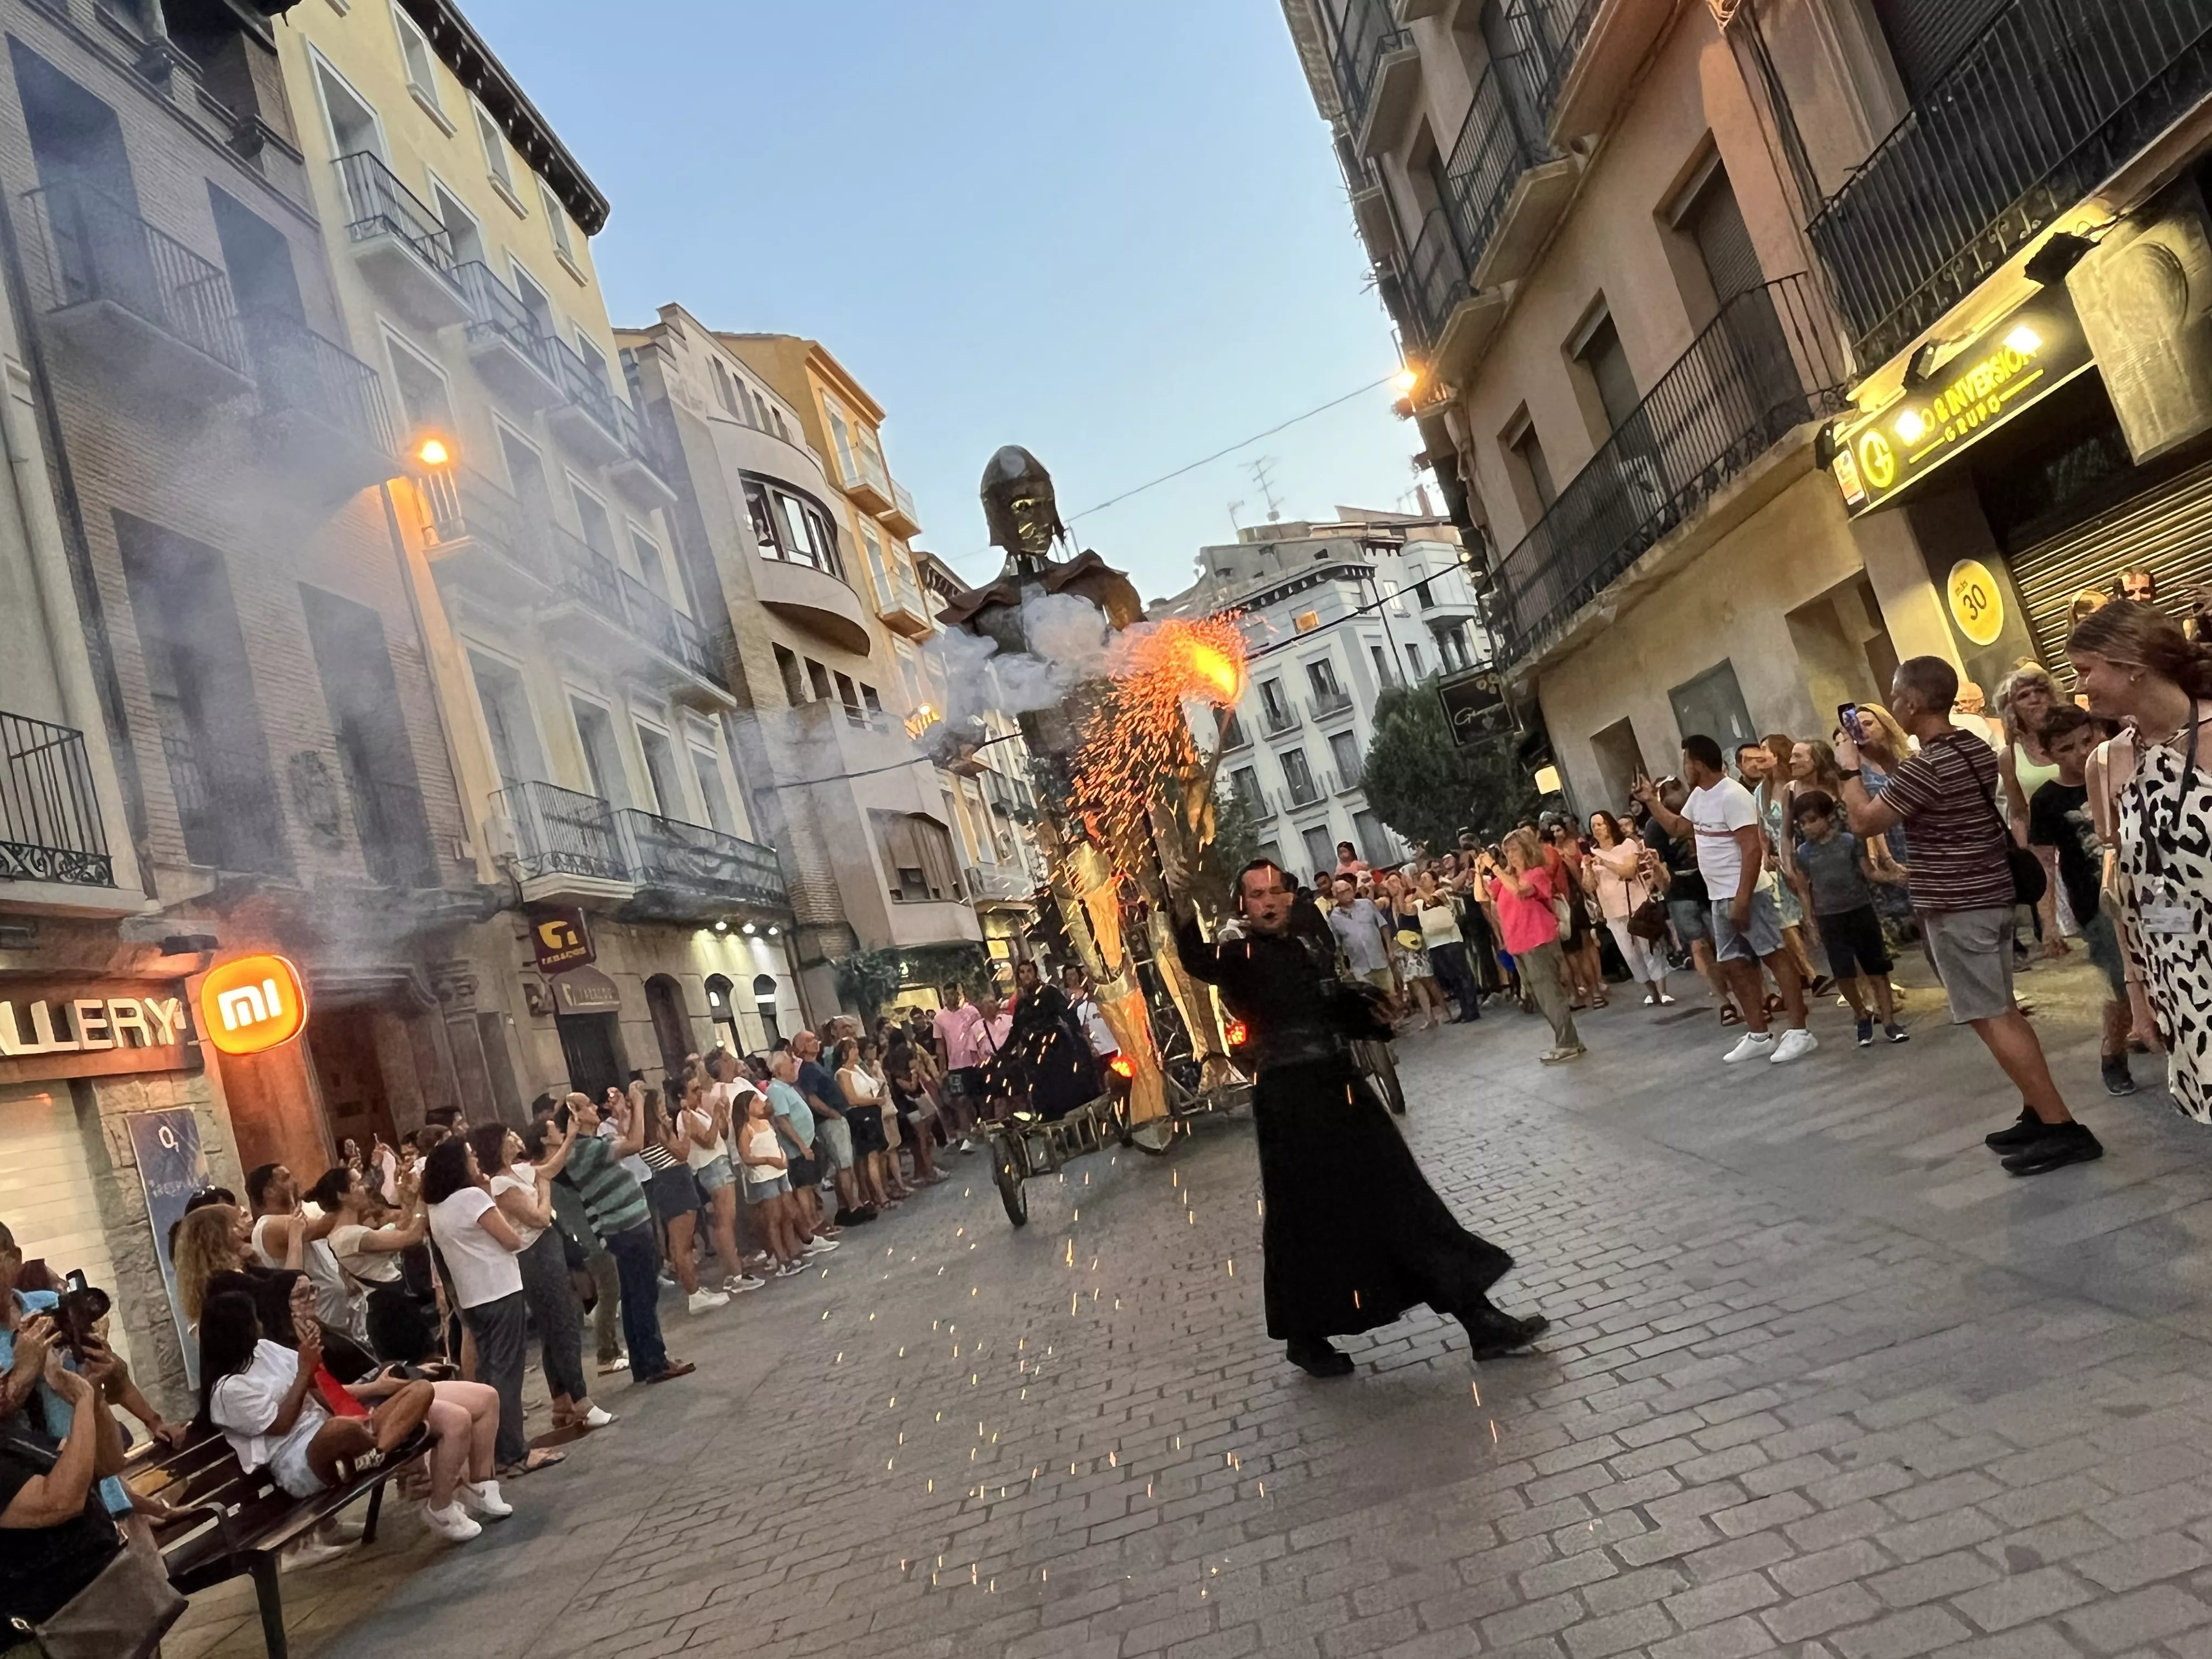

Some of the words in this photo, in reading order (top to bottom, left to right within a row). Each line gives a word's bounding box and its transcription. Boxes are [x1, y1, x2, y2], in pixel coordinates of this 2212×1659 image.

[1944, 394, 2001, 442] GRUPO
[1963, 584, 1987, 620] 30
[0, 997, 179, 1056] LLERY
